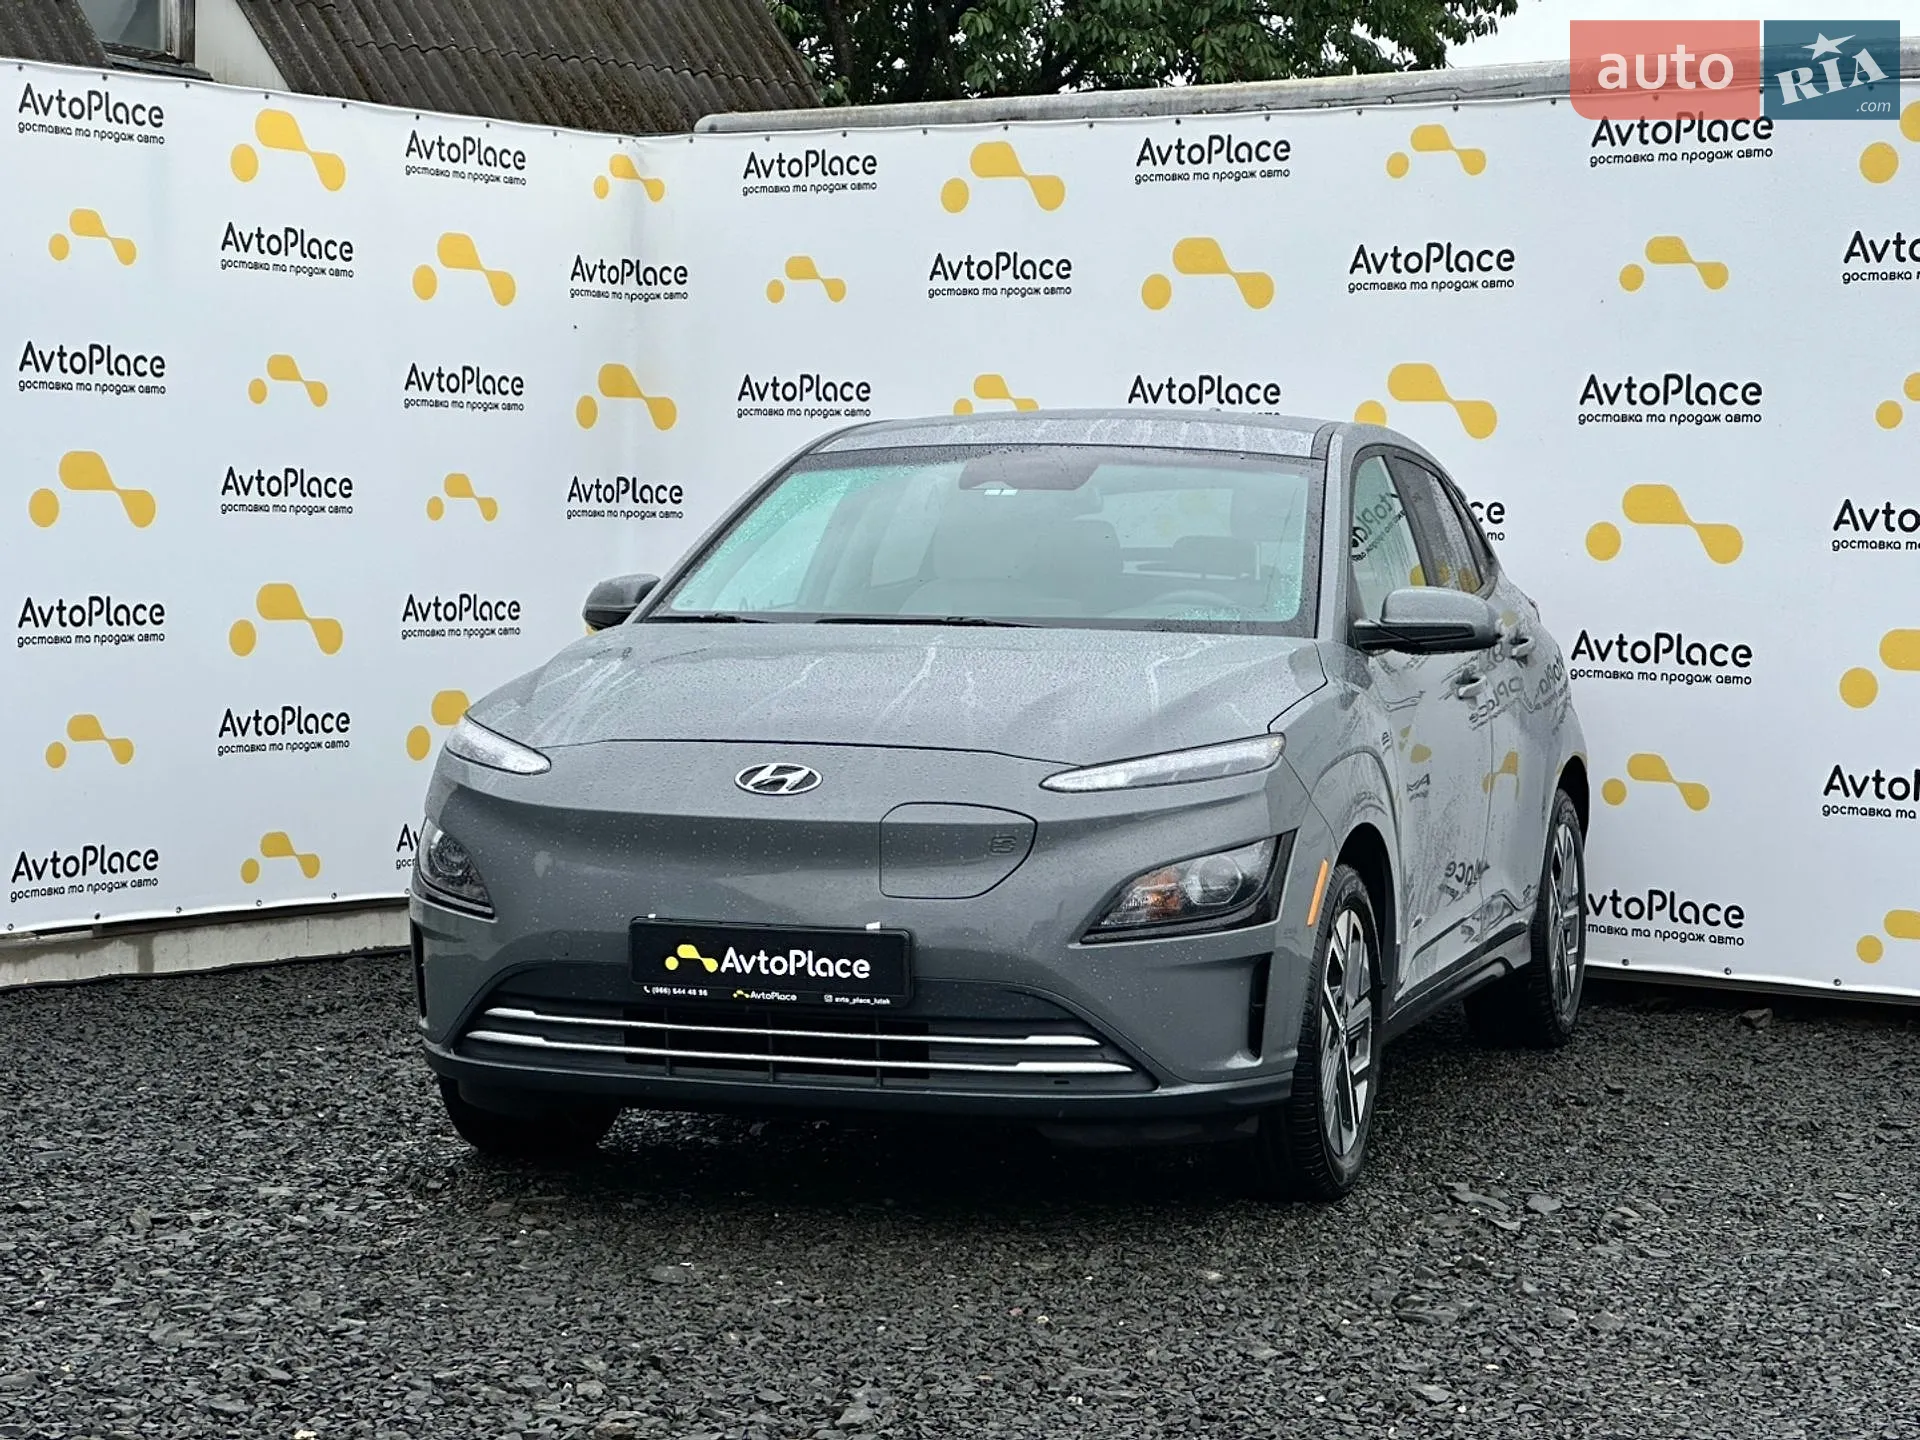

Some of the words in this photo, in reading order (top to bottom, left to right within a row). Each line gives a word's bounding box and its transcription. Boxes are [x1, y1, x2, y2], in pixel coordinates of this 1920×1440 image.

[18, 82, 164, 128] AvtoPlace
[18, 122, 72, 135] доставка
[75, 128, 91, 137] та
[94, 130, 134, 143] продаж
[136, 134, 165, 144] авто
[1591, 111, 1773, 148] AvtoPlace
[406, 130, 526, 170] AvtoPlace
[1136, 134, 1291, 167] AvtoPlace
[1590, 153, 1654, 168] доставка
[1658, 152, 1678, 162] та
[1682, 150, 1733, 164] продаж
[1736, 148, 1773, 158] авто
[406, 165, 450, 178] доставка
[452, 170, 466, 179] та
[468, 172, 500, 184] продаж
[503, 176, 526, 186] авто
[742, 149, 877, 179] AvtoPlace
[1135, 172, 1190, 185] доставка
[1193, 172, 1210, 180] та
[1212, 170, 1256, 182] продаж
[1259, 169, 1290, 178] авто
[742, 185, 790, 196] доставка
[792, 184, 807, 192] та
[810, 183, 848, 194] продаж
[850, 182, 877, 190] авто
[221, 222, 353, 262] AvtoPlace
[221, 259, 270, 270] доставка
[272, 264, 287, 272] та
[290, 265, 326, 277] продаж
[328, 268, 354, 278] авто
[930, 252, 1072, 281] AvtoPlace
[1350, 242, 1515, 274] AvtoPlace
[571, 254, 688, 286] AvtoPlace
[1842, 271, 1912, 284] доставка
[570, 288, 610, 298] доставка
[612, 292, 622, 300] та
[624, 292, 661, 303] продаж
[663, 292, 688, 300] авто
[928, 288, 979, 298] доставка
[1000, 287, 1041, 298] продаж
[1043, 287, 1072, 295] авто
[1348, 282, 1406, 294] доставка
[1410, 281, 1428, 290] та
[1431, 280, 1478, 292] продаж
[1482, 279, 1514, 288] авто
[19, 341, 165, 378] AvtoPlace
[19, 380, 73, 392] доставка
[76, 382, 92, 391] та
[95, 383, 136, 396] продаж
[138, 385, 166, 394] авто
[404, 363, 524, 396] AvtoPlace
[738, 374, 871, 403] AvtoPlace
[1128, 375, 1280, 405] AvtoPlace
[1580, 374, 1762, 406] AvtoPlace
[404, 398, 449, 409] доставка
[451, 400, 464, 408] та
[466, 401, 499, 412] продаж
[502, 403, 524, 411] авто
[737, 408, 784, 418] доставка
[787, 408, 802, 416] та
[804, 408, 842, 419] продаж
[844, 408, 871, 417] авто
[1578, 414, 1642, 425] доставка
[1646, 414, 1666, 422] та
[1670, 414, 1721, 426] продаж
[1725, 414, 1762, 422] авто
[222, 466, 353, 498] AvtoPlace
[568, 476, 683, 504] AvtoPlace
[220, 504, 270, 514] доставка
[272, 504, 287, 512] та
[289, 505, 326, 516] продаж
[328, 506, 353, 514] авто
[567, 510, 605, 520] доставка
[620, 510, 656, 520] продаж
[1832, 540, 1901, 551] доставка
[1905, 541, 1920, 550] т
[18, 596, 165, 628] AvtoPlace
[402, 594, 520, 622] AvtoPlace
[18, 635, 72, 648] доставка
[75, 635, 91, 644] та
[94, 634, 134, 646] продаж
[138, 633, 165, 642] авто
[402, 629, 446, 640] доставка
[448, 628, 461, 636] та
[463, 628, 496, 638] продаж
[498, 627, 520, 635] авто
[1571, 630, 1752, 667] AvtoPlace
[1570, 668, 1634, 680] доставка
[1638, 672, 1657, 681] та
[1660, 672, 1712, 685] продаж
[1716, 675, 1752, 685] авто
[218, 706, 350, 738] AvtoPlace
[218, 744, 266, 756] доставка
[269, 743, 283, 751] та
[286, 742, 322, 752] продаж
[324, 740, 350, 748] авто
[1822, 804, 1891, 818] доставка
[1895, 809, 1916, 819] та
[11, 844, 159, 883] AvtoPlace
[10, 886, 65, 903] доставка
[68, 884, 84, 894] та
[87, 880, 128, 894] продаж
[130, 878, 158, 888] авто
[1587, 888, 1744, 929] vtoPlace
[1588, 924, 1628, 936] тавка
[1631, 928, 1650, 937] та
[1654, 930, 1705, 943] продаж
[1708, 935, 1744, 946] авто
[720, 946, 871, 979] AvtoPlace
[750, 990, 797, 1001] AvtoPlace
